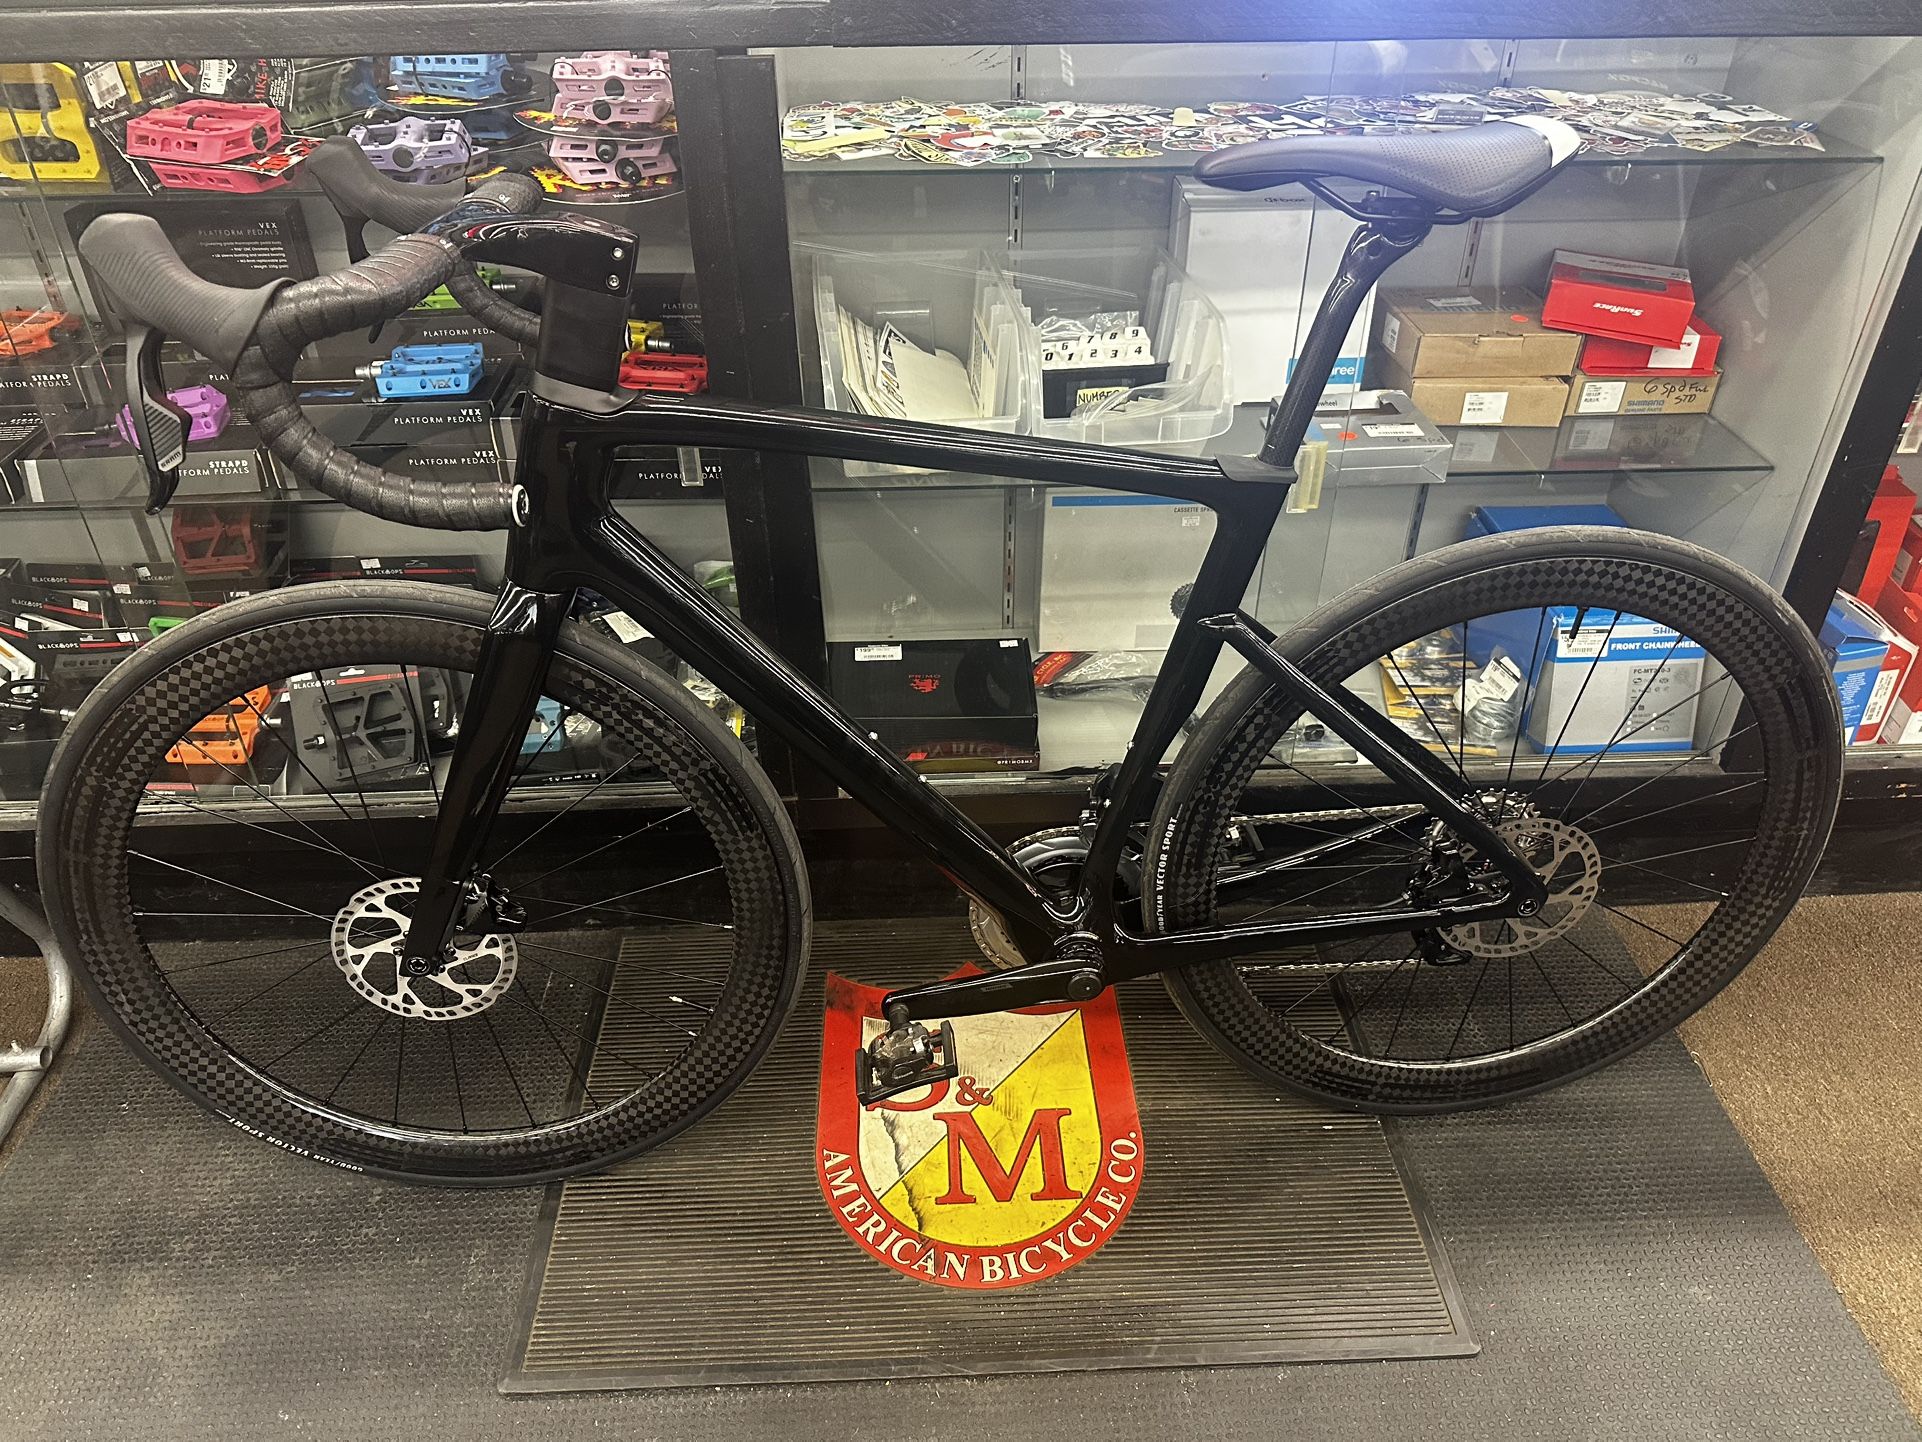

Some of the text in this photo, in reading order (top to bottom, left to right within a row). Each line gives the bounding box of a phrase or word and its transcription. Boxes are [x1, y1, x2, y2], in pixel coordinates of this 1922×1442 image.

[198, 228, 280, 237] PLATFORM PEDALS
[423, 328, 469, 337] PLATFORM
[1061, 329, 1139, 351] 6 7 8 9
[1044, 346, 1142, 361] 0 1 2 3 4
[31, 373, 69, 381] STRAPD
[428, 378, 452, 389] VEX
[1643, 377, 1659, 394] 6
[460, 408, 481, 416] VEX
[394, 417, 443, 425] PLATFORM
[474, 450, 496, 458] VEX
[208, 459, 248, 469] STRAPD
[409, 457, 496, 466] PLATFORM PEDALS
[214, 467, 250, 475] PEDALS
[638, 472, 682, 480] PLATFOR
[1610, 642, 1641, 651] FRONT
[1156, 816, 1178, 932] OODYEAR VECTOR SPORT
[955, 1075, 993, 1106] &
[227, 1116, 265, 1139] SPORT
[266, 1135, 309, 1157] VECTOR
[933, 1108, 1084, 1205] M
[822, 1131, 1138, 1282] AMERICAN BICYCLE CO.
